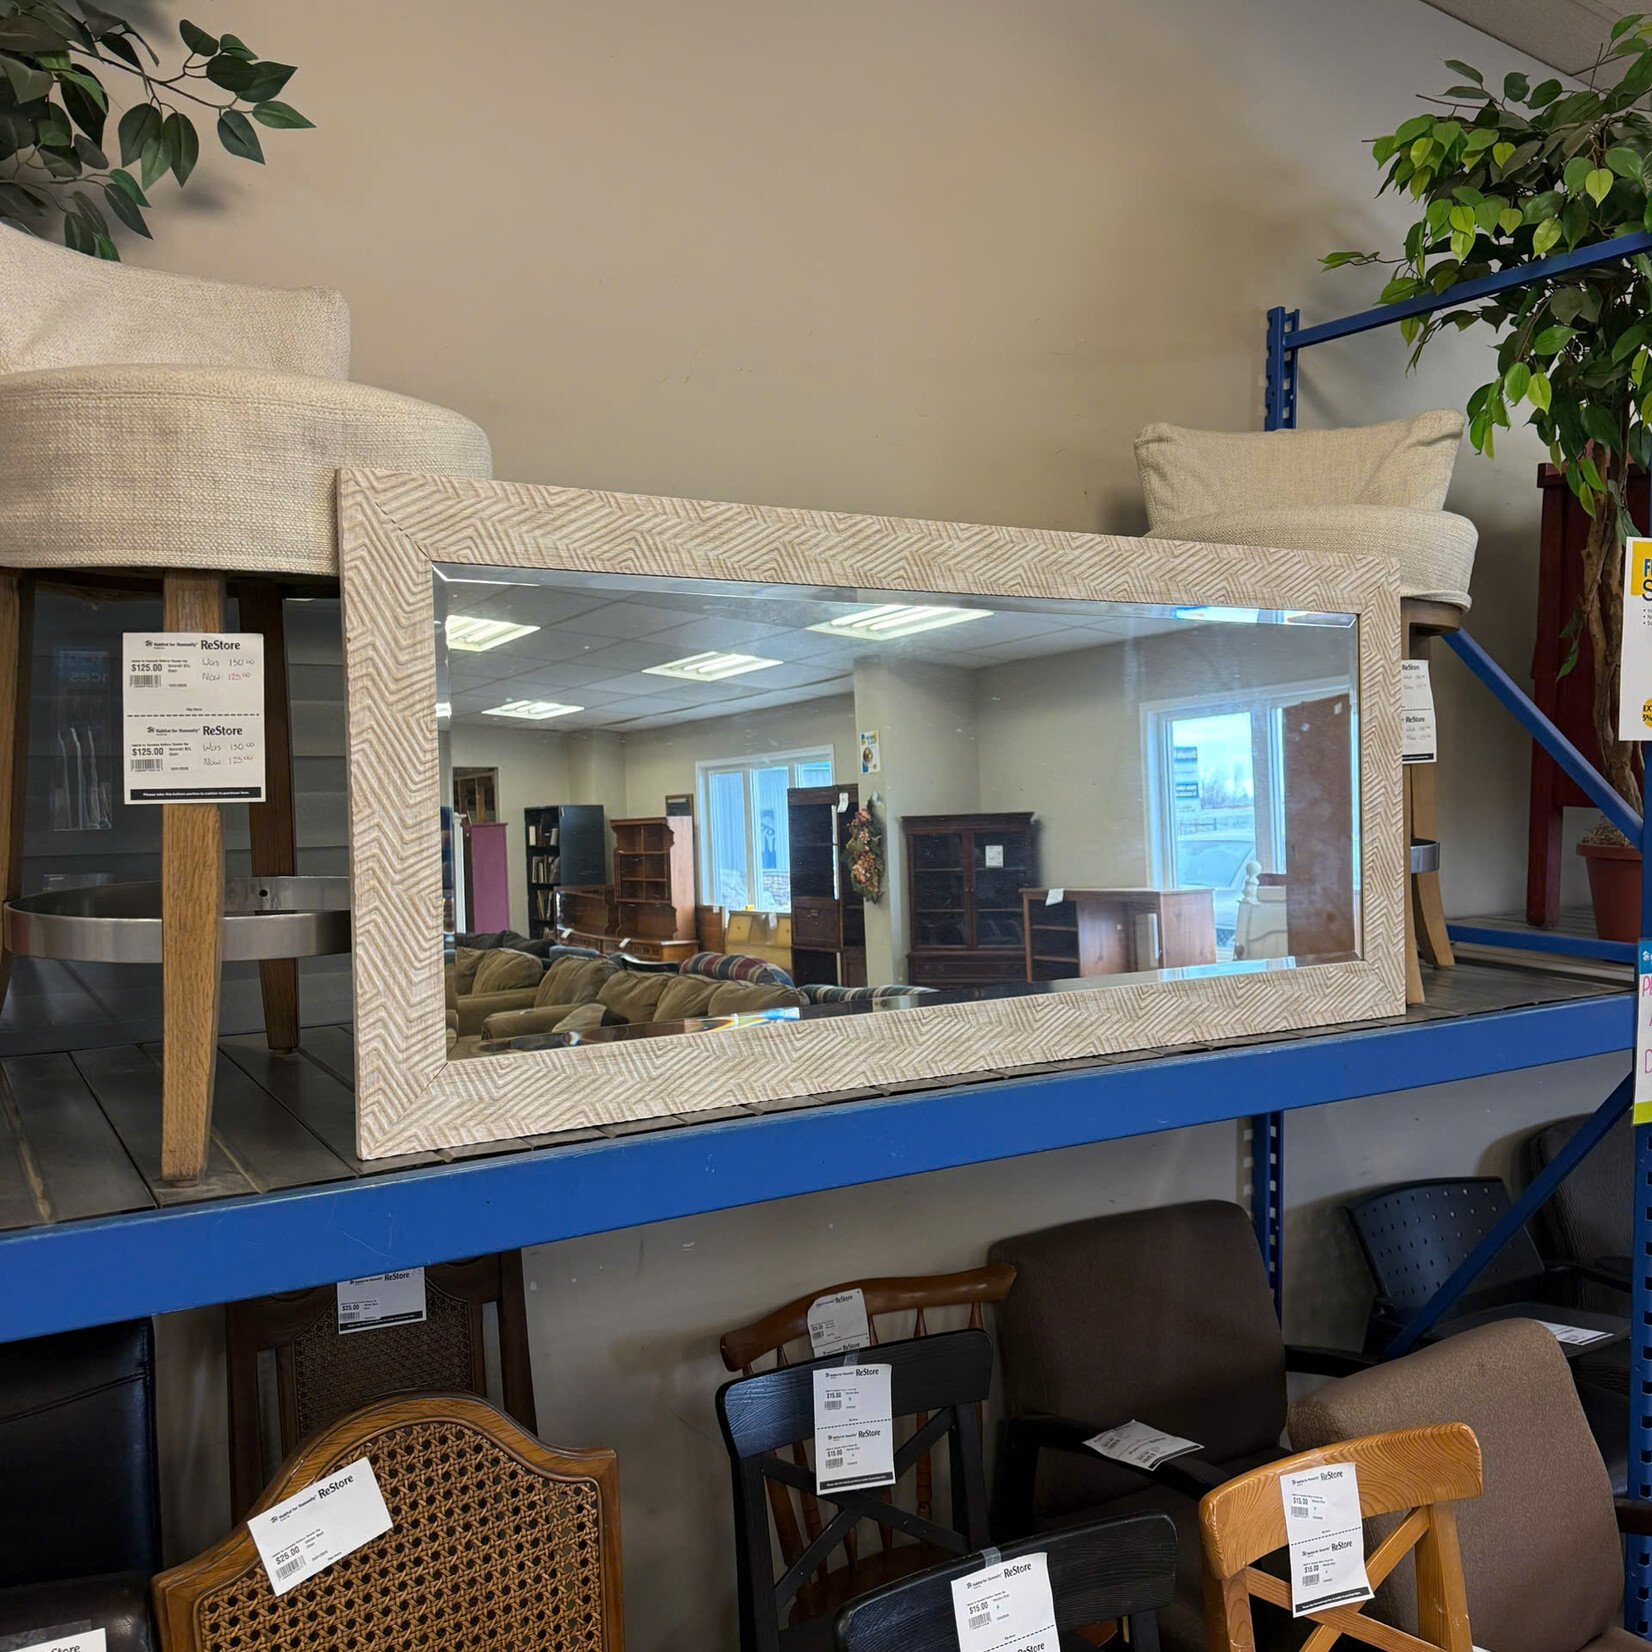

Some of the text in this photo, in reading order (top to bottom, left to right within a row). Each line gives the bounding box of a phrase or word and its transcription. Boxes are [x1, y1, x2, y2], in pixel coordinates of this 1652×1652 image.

[200, 640, 241, 650] ReStore
[131, 664, 163, 672] $125.00
[203, 725, 243, 736] ReStore
[132, 747, 164, 756] $125.00
[384, 1272, 410, 1281] ReStore
[856, 1367, 879, 1376] ReStore
[858, 1429, 881, 1438] ReStore
[318, 1474, 354, 1499] ReStore
[1331, 1540, 1353, 1552] ReStore
[275, 1546, 300, 1565] $25.00
[1003, 1562, 1032, 1579] ReStore
[969, 1601, 989, 1614] $15.00
